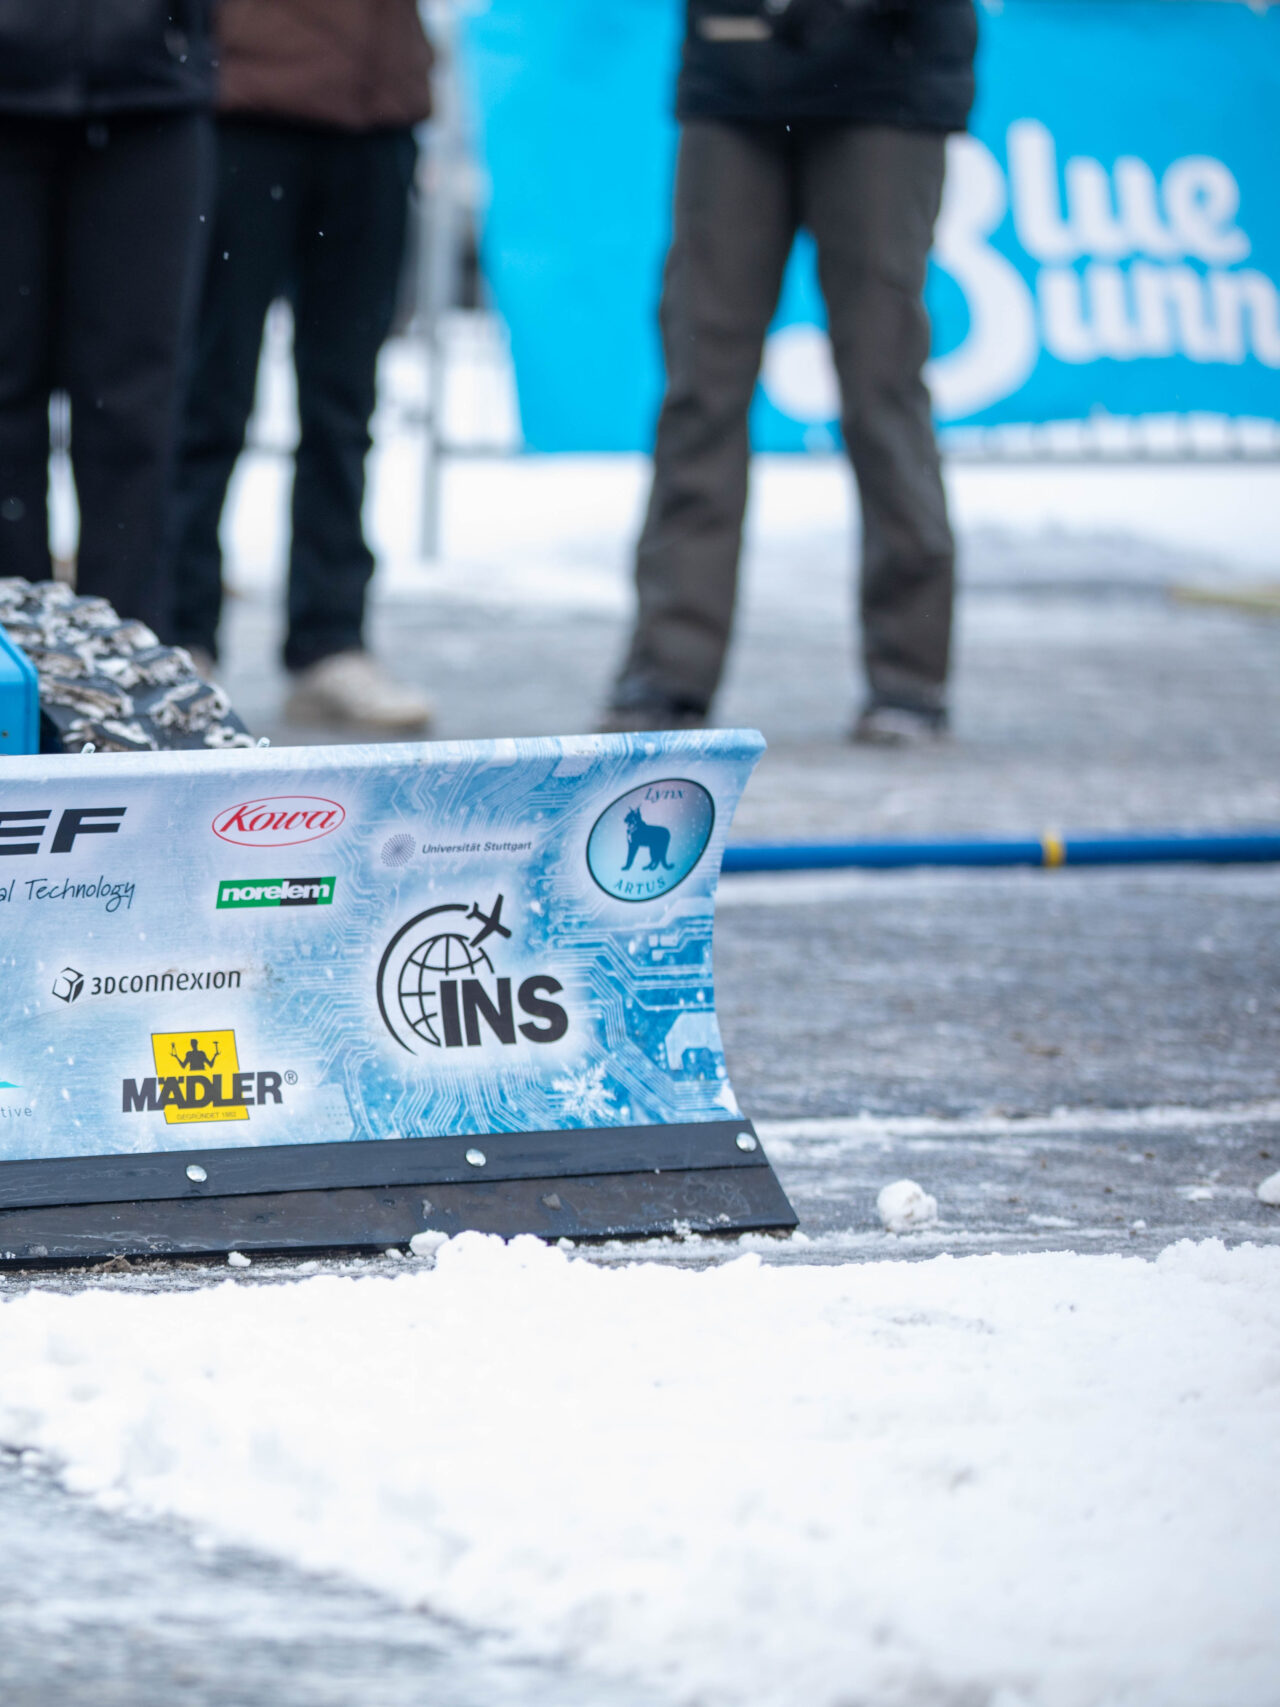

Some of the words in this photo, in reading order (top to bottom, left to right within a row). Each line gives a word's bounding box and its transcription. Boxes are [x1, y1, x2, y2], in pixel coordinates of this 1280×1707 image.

[645, 787, 685, 804] Lynx
[220, 804, 340, 832] Kowa
[422, 842, 481, 855] Universität
[483, 841, 532, 854] Stuttgart
[25, 875, 136, 913] Technology
[221, 880, 331, 903] norelem
[614, 876, 666, 895] ARTUS
[439, 974, 568, 1048] INS
